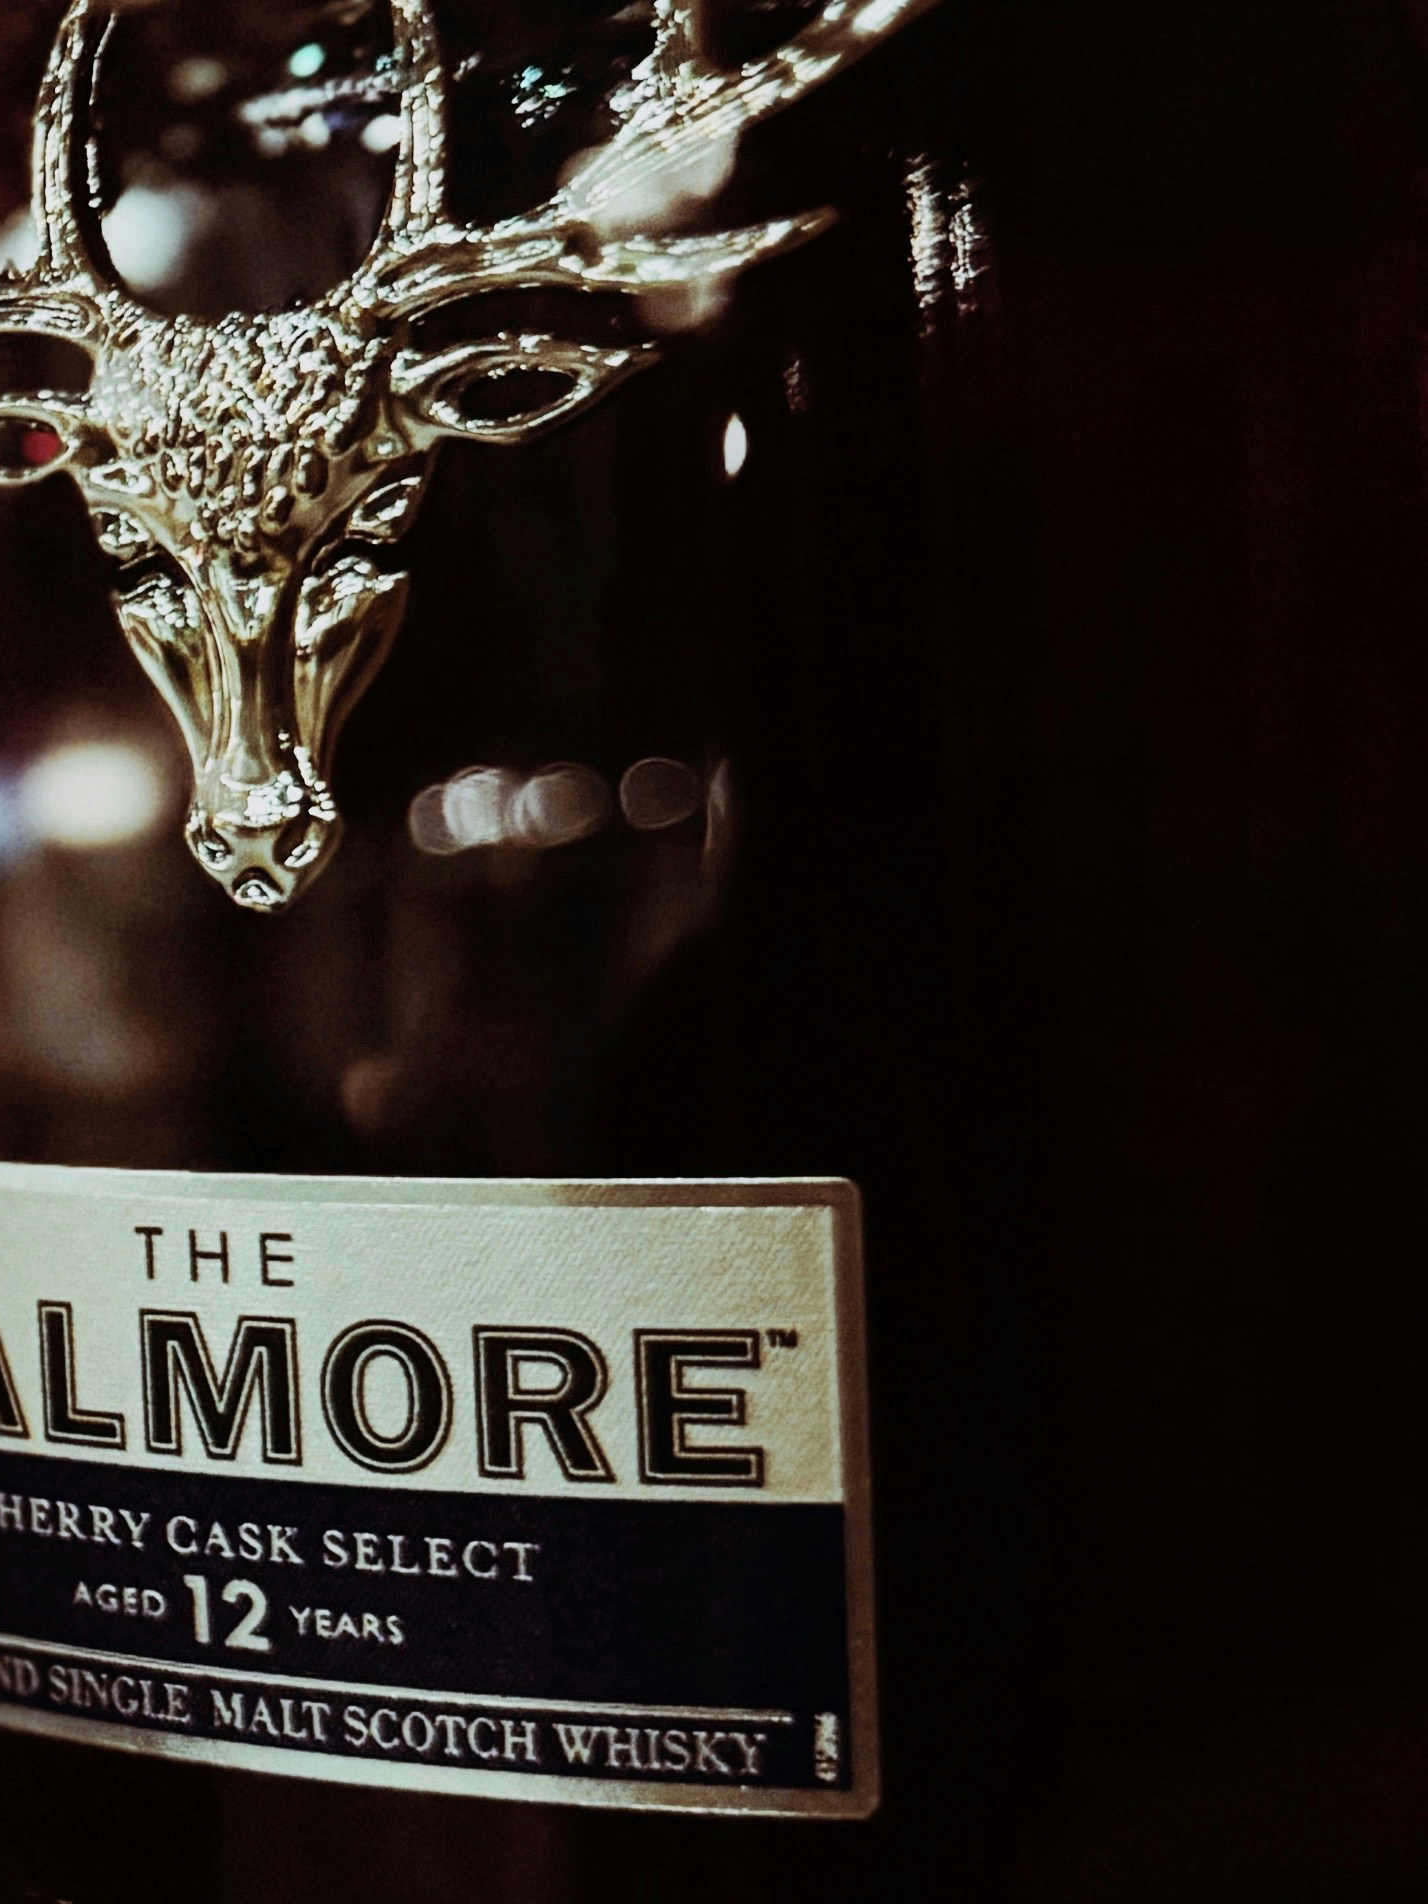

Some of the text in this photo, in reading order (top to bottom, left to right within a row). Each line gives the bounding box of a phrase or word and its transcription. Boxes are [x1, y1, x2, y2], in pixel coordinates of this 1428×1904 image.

[133, 1225, 295, 1288] THE
[166, 1515, 305, 1566] CASK
[322, 1528, 542, 1582] SELECT
[72, 1573, 404, 1654] AGED 12 YEARS
[47, 1664, 192, 1724] SINGLE
[211, 1687, 334, 1743] MALT
[344, 1705, 539, 1763] SCOTCH
[552, 1720, 768, 1776] WHISKY
